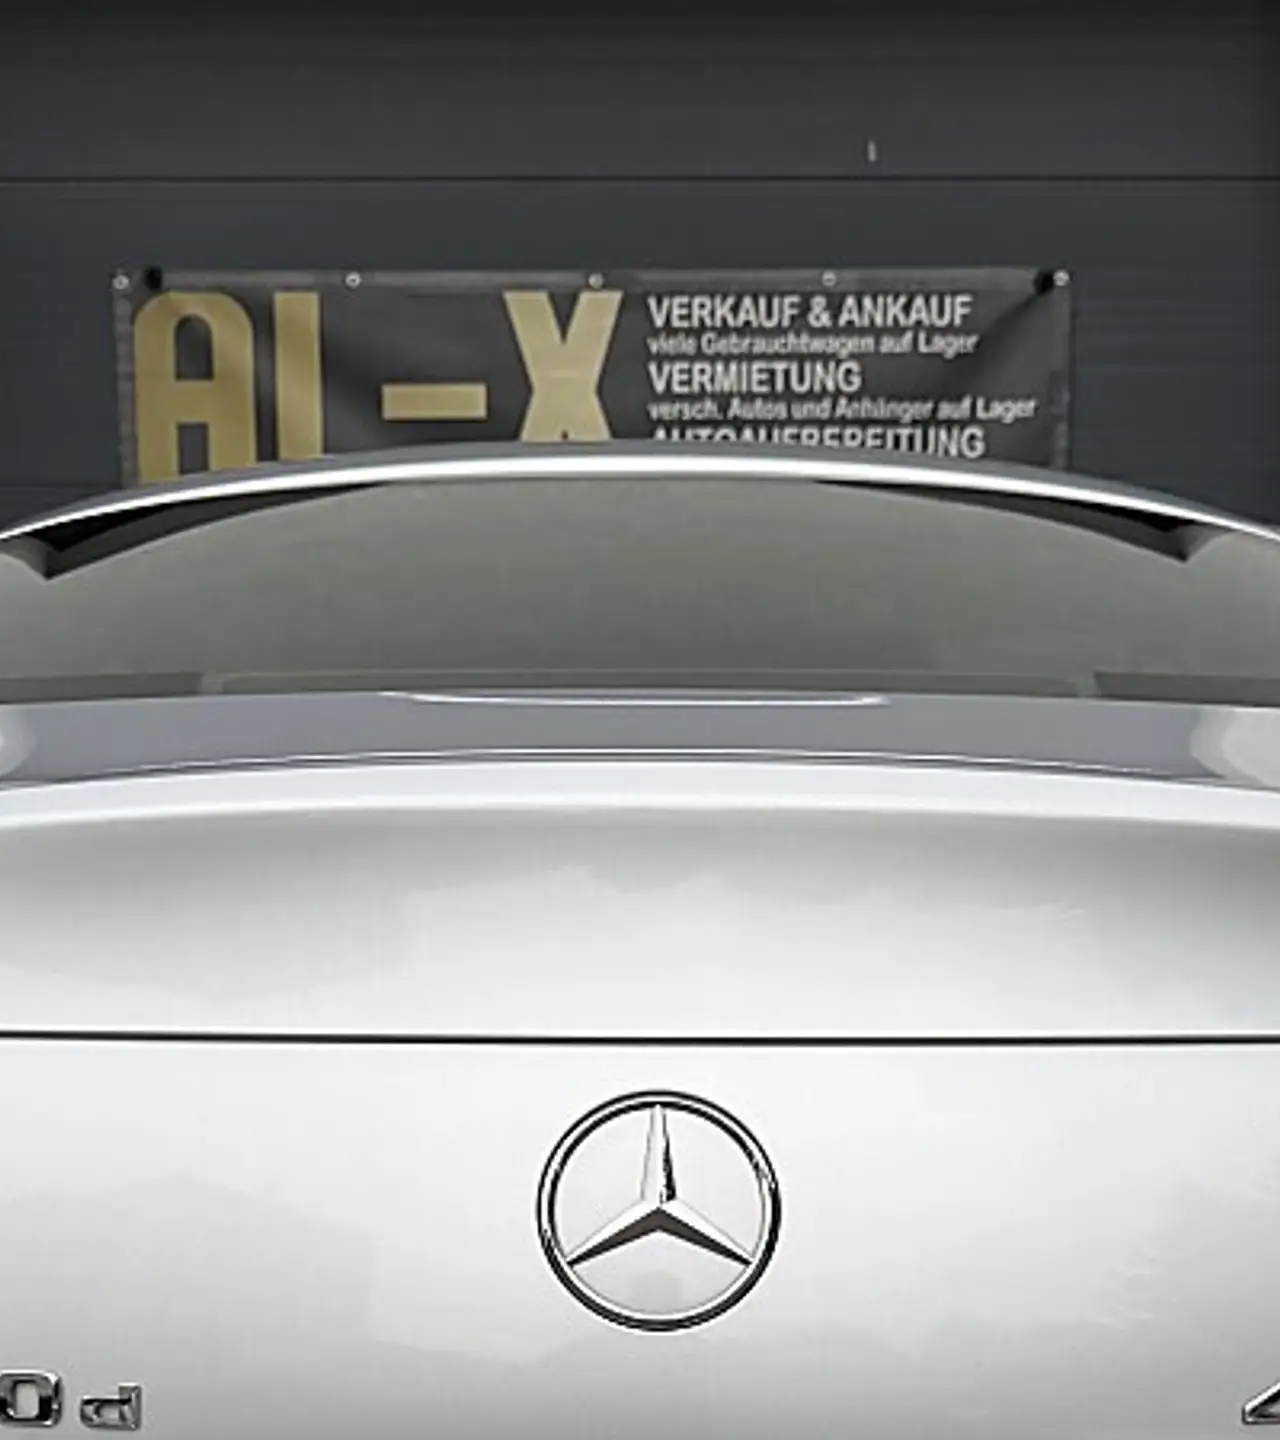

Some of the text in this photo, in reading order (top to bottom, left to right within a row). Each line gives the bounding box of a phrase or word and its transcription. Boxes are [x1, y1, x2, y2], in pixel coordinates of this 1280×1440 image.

[648, 294, 972, 328] VERKAUF & ANKAUF
[646, 331, 979, 359] viele Gebrauchtwagen auf Lager
[648, 360, 862, 394] VERMIETUNG
[727, 398, 788, 420] Autos
[791, 398, 833, 420] und
[835, 397, 934, 423] Anhänger
[937, 396, 971, 420] auf
[976, 397, 1036, 423] Lager
[80, 1382, 142, 1431] d
